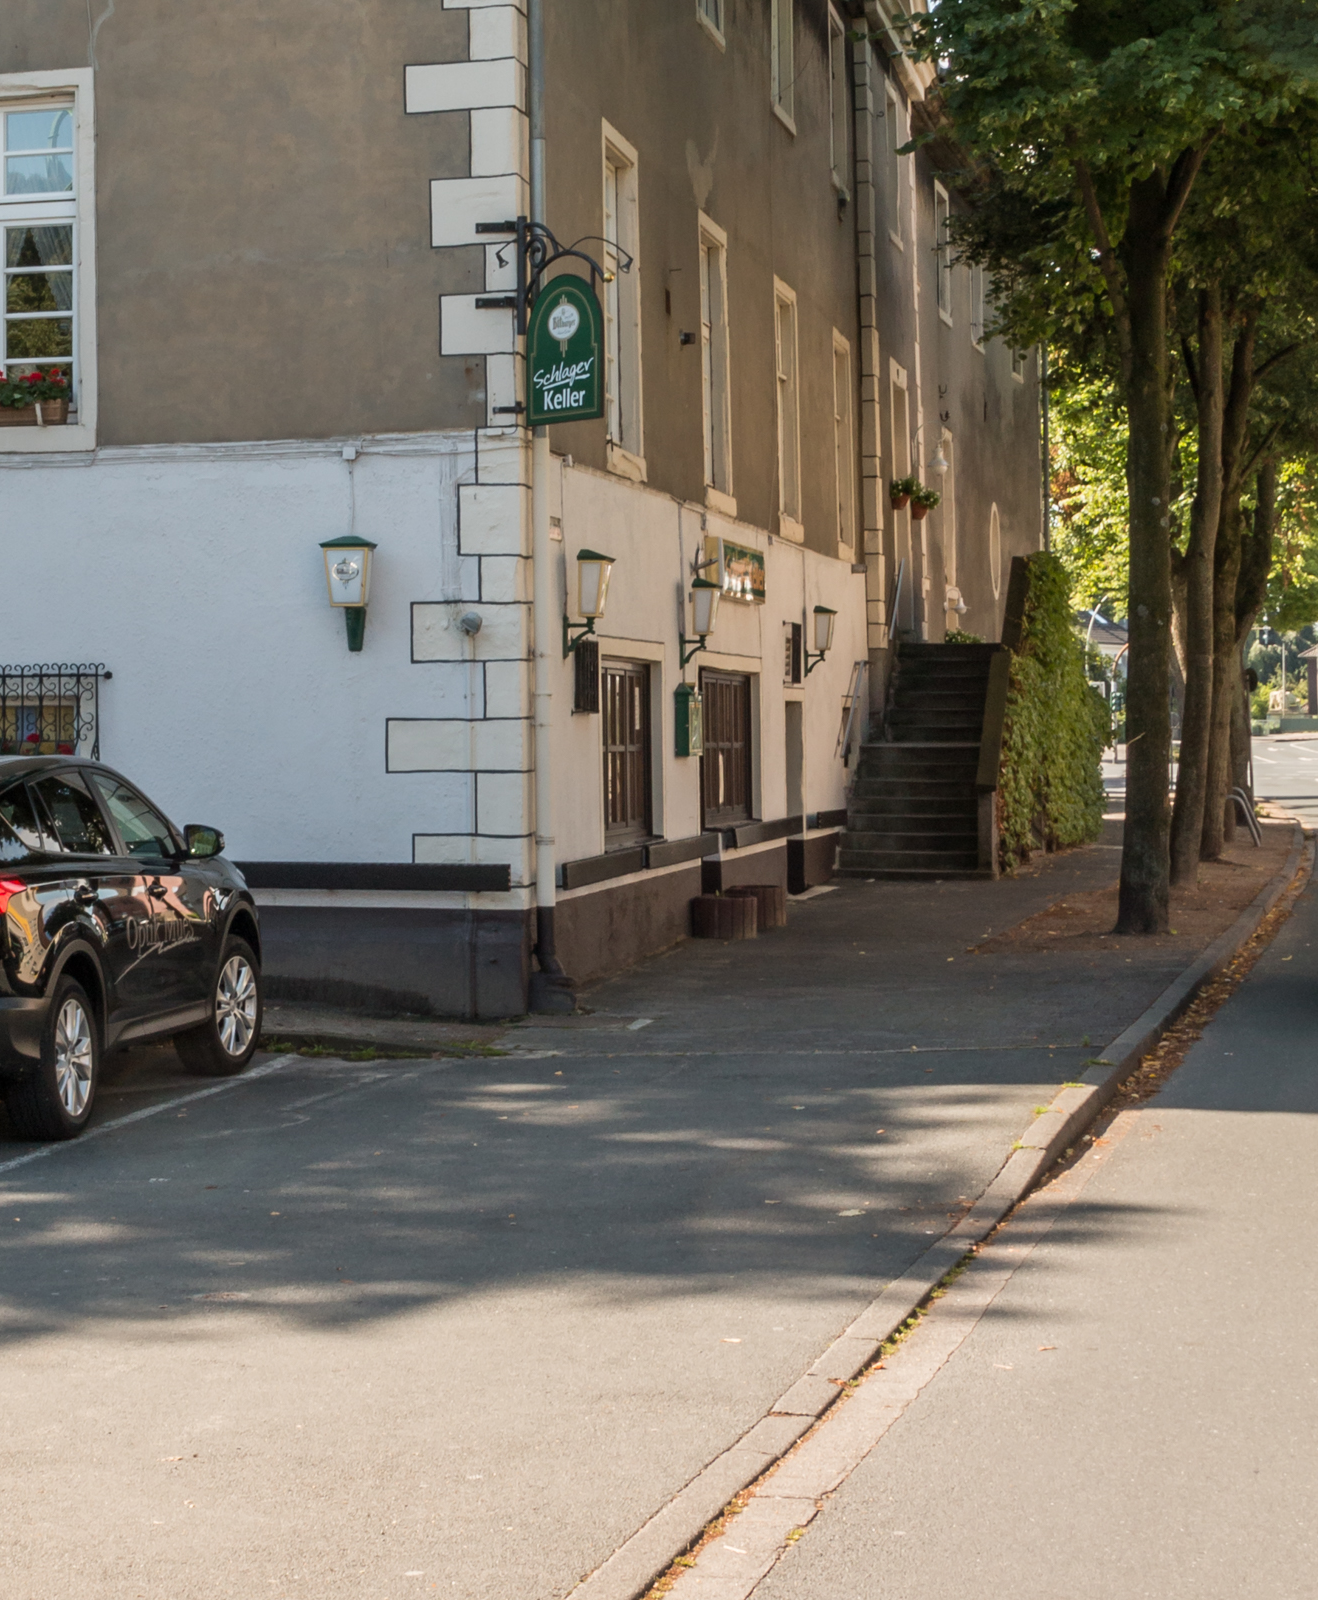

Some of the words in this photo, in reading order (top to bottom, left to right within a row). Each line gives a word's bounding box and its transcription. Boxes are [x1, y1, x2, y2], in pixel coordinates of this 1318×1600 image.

[534, 357, 594, 389] Schlager
[543, 389, 586, 411] Keller
[127, 914, 160, 958] Optik
